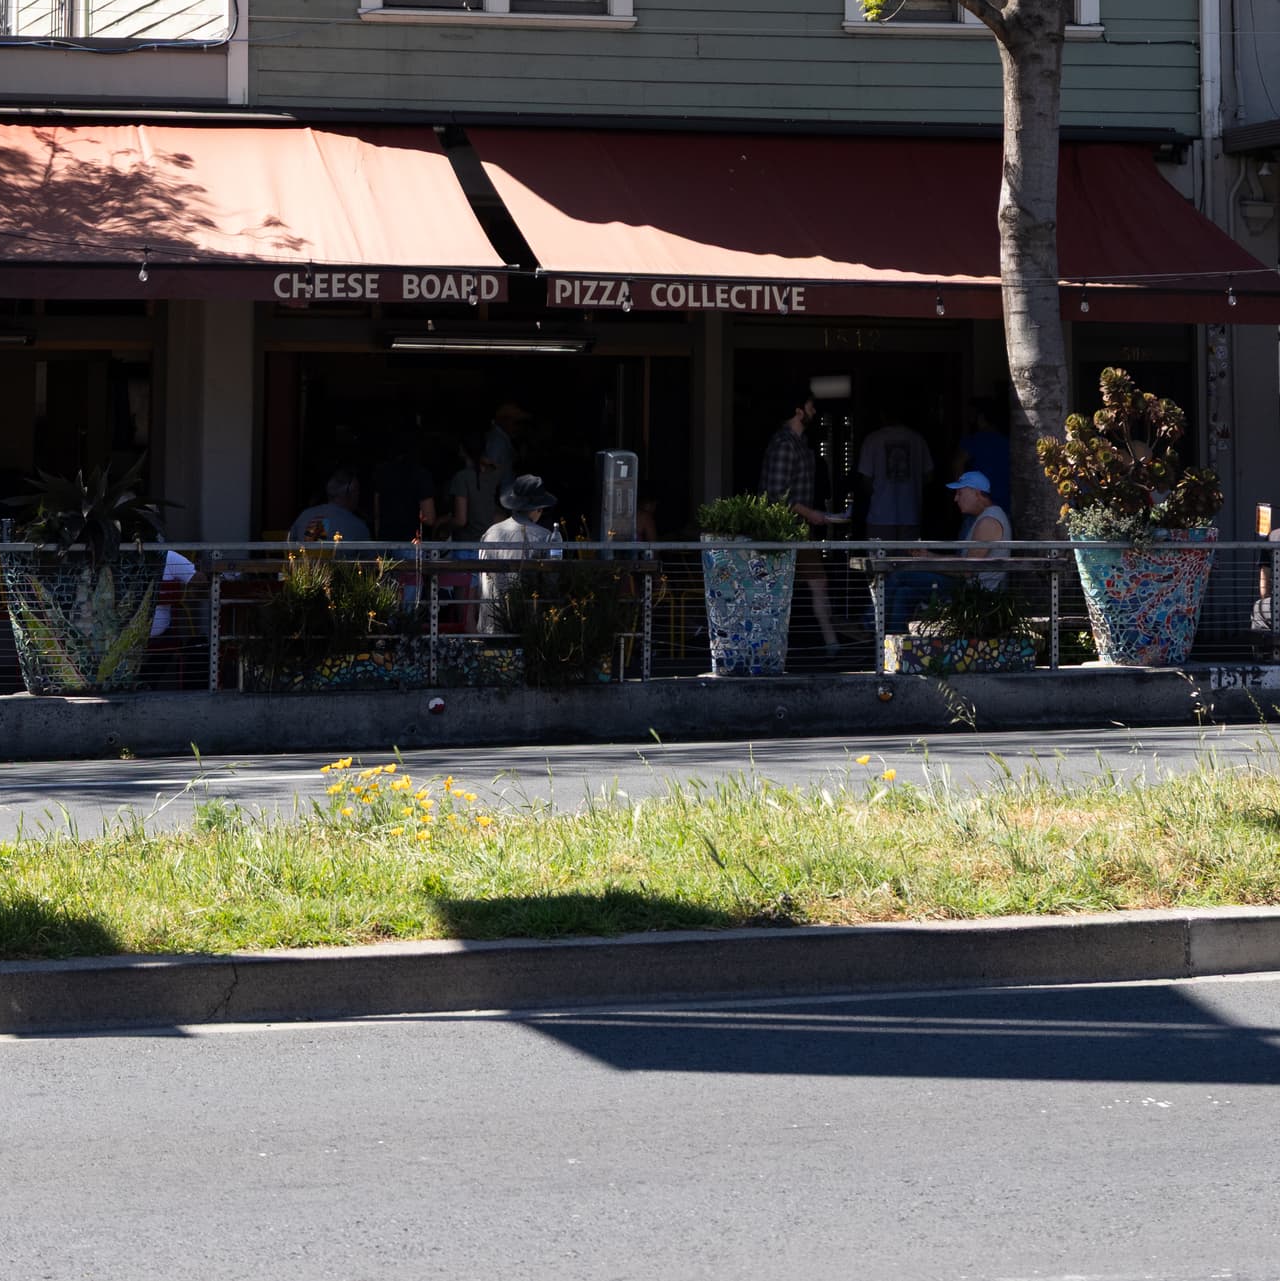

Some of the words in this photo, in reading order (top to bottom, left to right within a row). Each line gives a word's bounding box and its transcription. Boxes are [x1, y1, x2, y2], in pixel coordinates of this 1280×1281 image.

[273, 273, 380, 300] CHEESE
[402, 274, 500, 301] BOARD
[555, 279, 634, 307] PIZZA
[650, 282, 806, 312] COLLECTIVE
